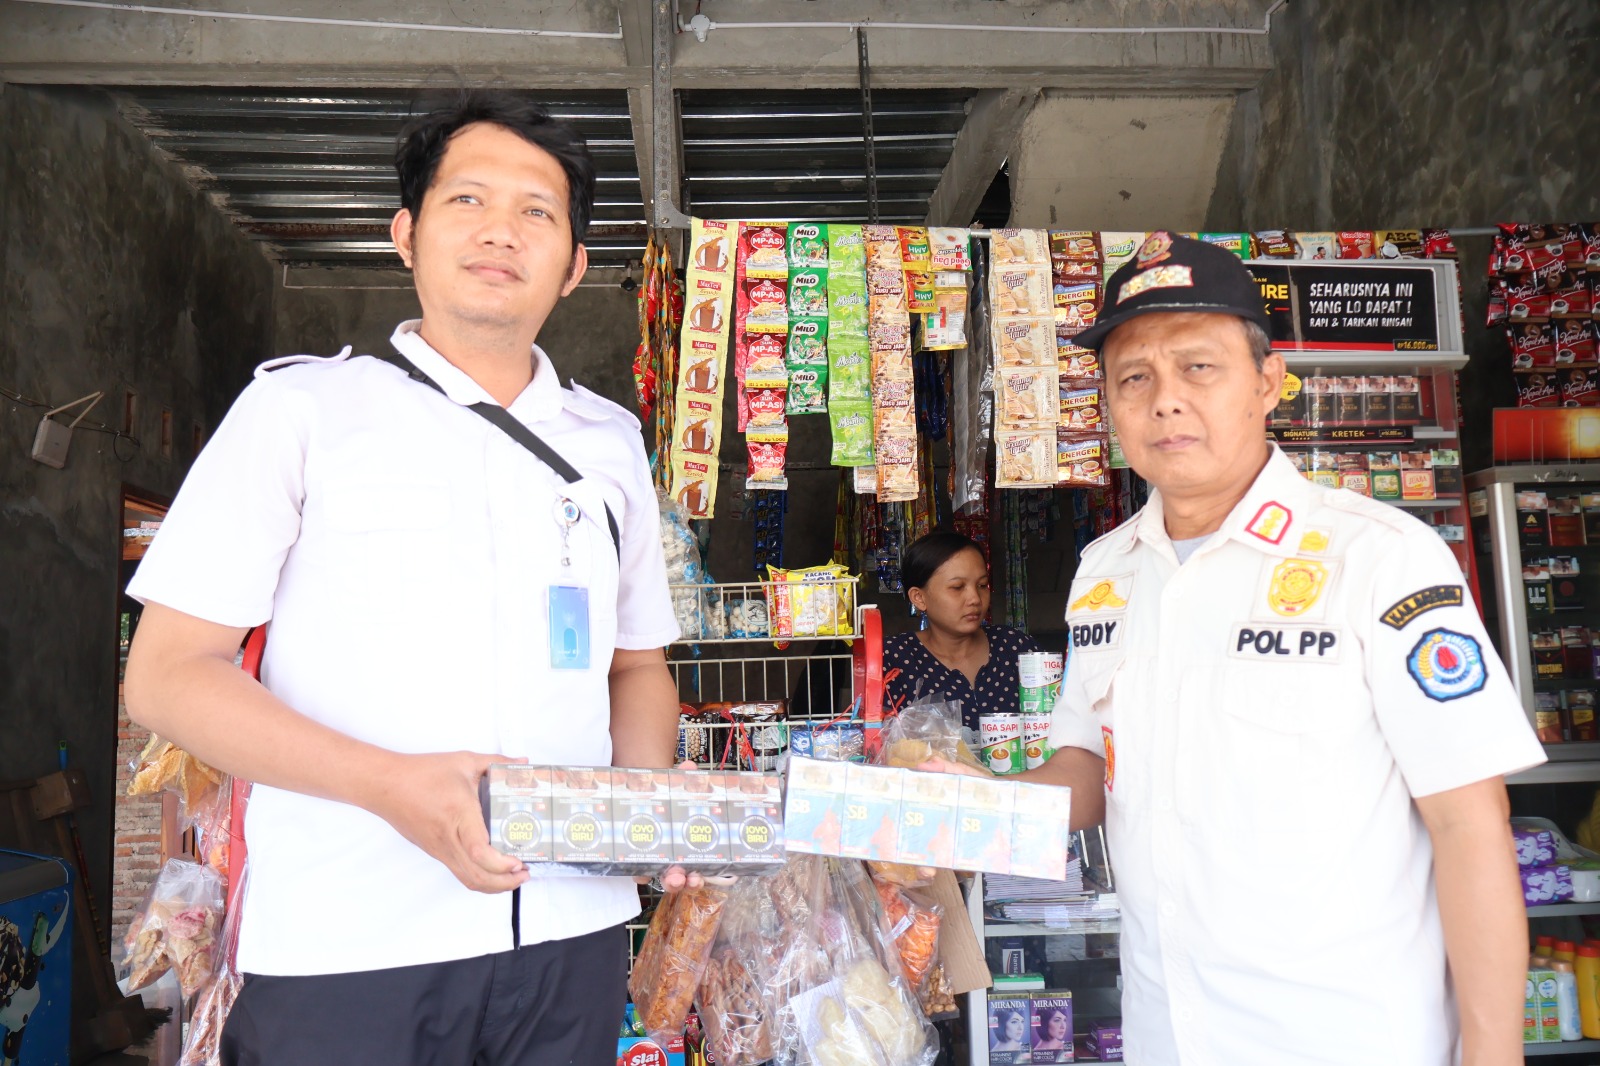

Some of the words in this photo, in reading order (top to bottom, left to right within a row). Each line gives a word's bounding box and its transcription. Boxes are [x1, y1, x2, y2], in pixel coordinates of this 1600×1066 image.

[752, 237, 783, 245] MP-ASI
[1386, 232, 1416, 242] ABC
[1105, 241, 1136, 254] BONTEH
[1309, 282, 1390, 297] SEHARUSNYA
[1395, 283, 1413, 297] INI
[752, 291, 783, 299] MP-ASI
[1057, 290, 1093, 301] ENERGEN
[1309, 300, 1342, 314] YANG
[1346, 301, 1361, 314] LO
[1365, 300, 1403, 314] DAPAT
[1406, 301, 1411, 313] !
[1309, 317, 1328, 328] RAPI
[1331, 318, 1339, 328] &
[1343, 317, 1379, 328] TARIKAN
[1381, 317, 1413, 327] RINGAN
[795, 325, 816, 333] MILO
[1580, 329, 1592, 339] Api
[1537, 335, 1550, 345] Api
[1542, 385, 1555, 395] Api
[1583, 380, 1596, 391] Api
[751, 401, 783, 409] MP-ASI
[1060, 395, 1095, 406] ENERGEN
[1283, 430, 1319, 438] SIGNATURE
[1331, 430, 1365, 438] KRETEK
[1060, 448, 1098, 460] ENERGEN
[752, 455, 784, 464] MP-ASI
[1072, 621, 1118, 648] EDDY
[1237, 628, 1291, 656] POL
[1299, 630, 1337, 657] PP
[982, 723, 999, 732] TIGA
[1000, 723, 1018, 732] SAPI
[791, 800, 811, 813] SB
[848, 804, 867, 820] SB
[904, 811, 924, 826] SB
[961, 816, 981, 833] SB
[509, 831, 533, 841] BIRU
[571, 832, 594, 842] BIRU
[632, 833, 654, 842] BIRU
[690, 833, 712, 843] BIRU
[746, 833, 768, 843] BIRU
[990, 1000, 1026, 1009] MIRANDA
[1033, 999, 1069, 1008] MIRANDA
[631, 1050, 660, 1063] Slai
